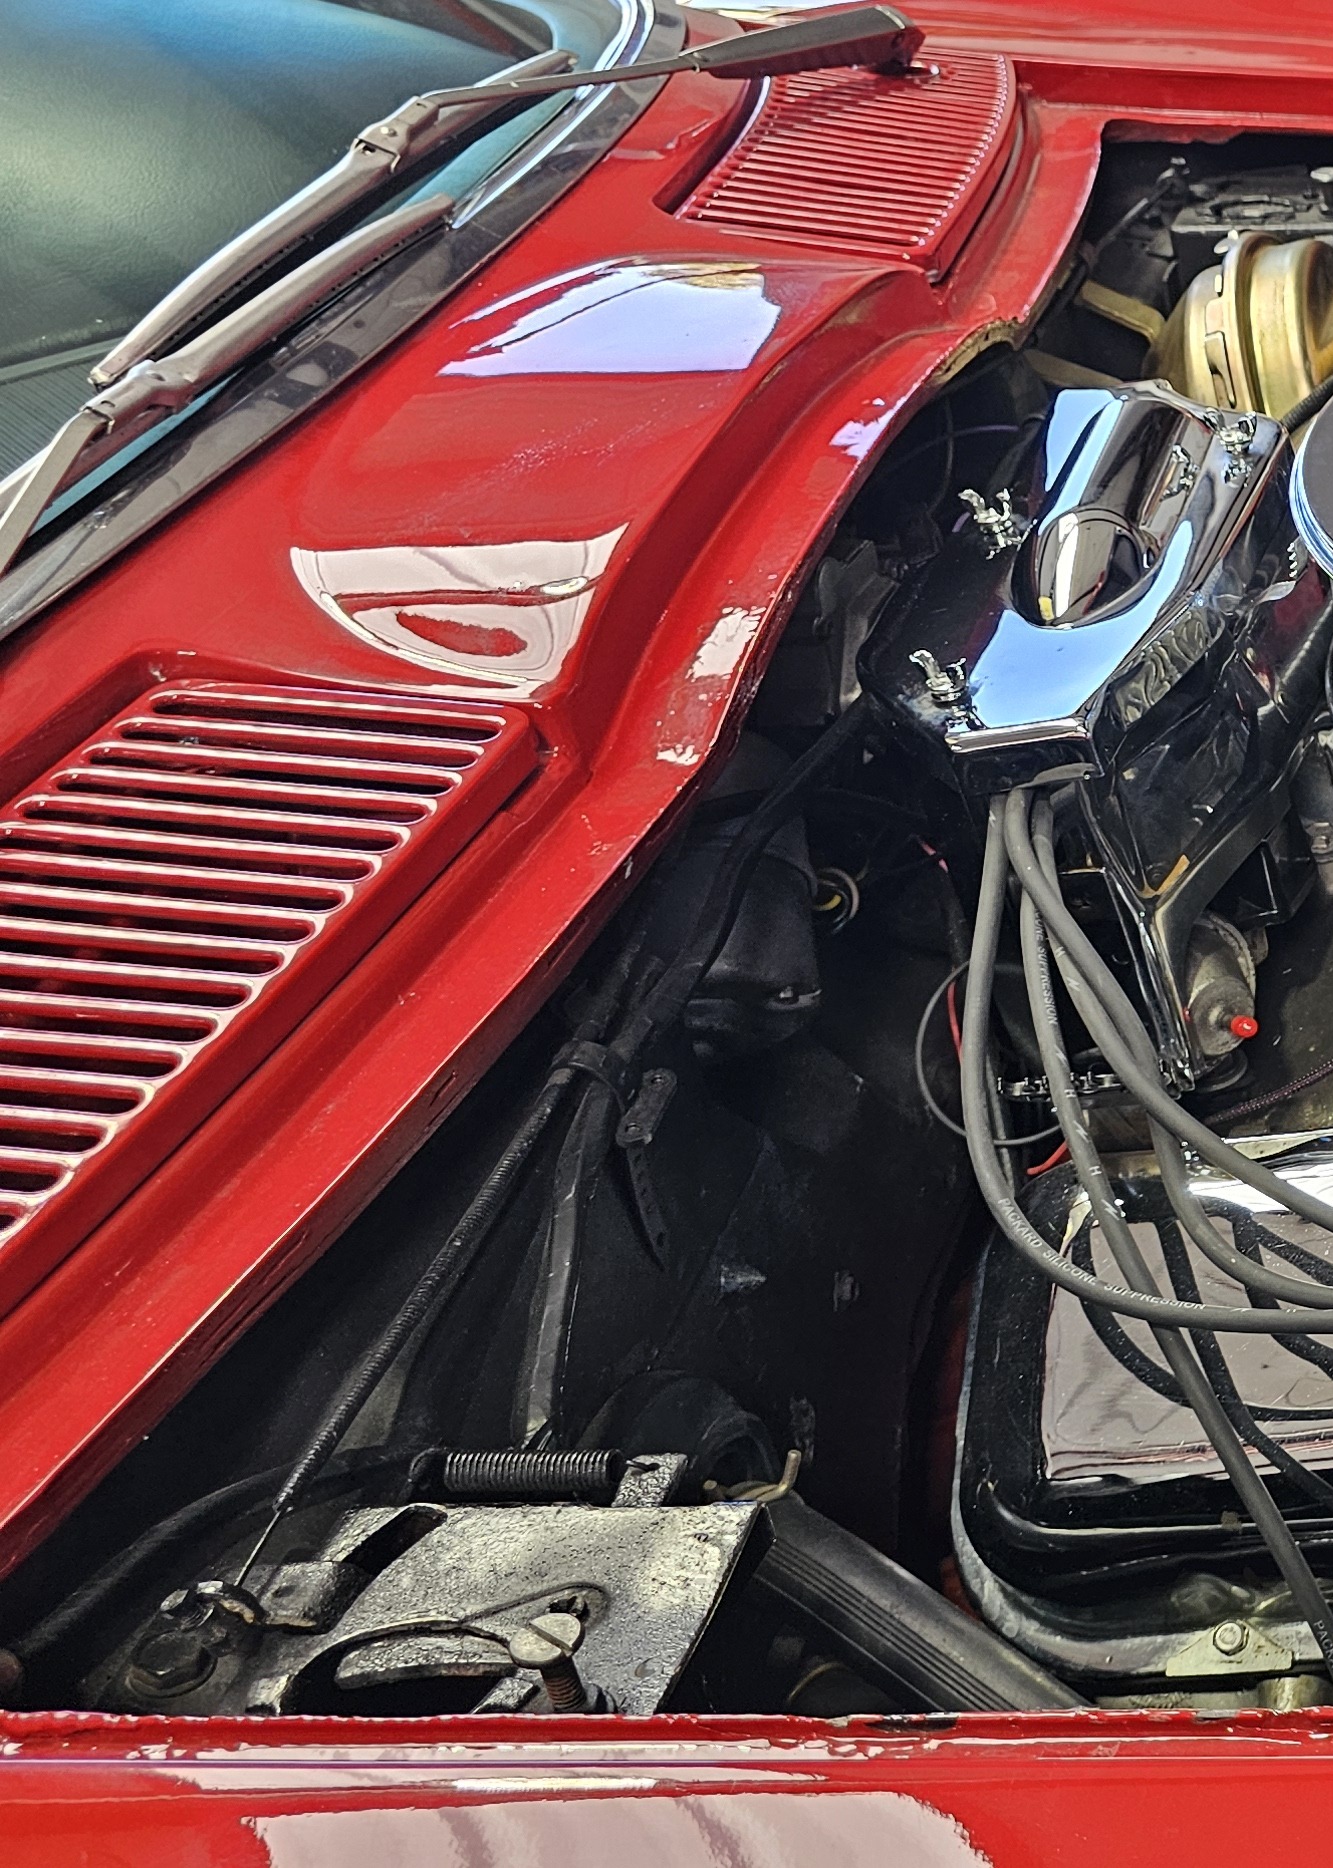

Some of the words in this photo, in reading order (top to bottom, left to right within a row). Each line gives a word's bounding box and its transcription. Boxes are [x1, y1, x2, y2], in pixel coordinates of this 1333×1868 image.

[997, 1197, 1042, 1249] PACKARD
[1042, 1248, 1099, 1287] SILICONE
[1103, 1281, 1206, 1311] SUPPRESSION
